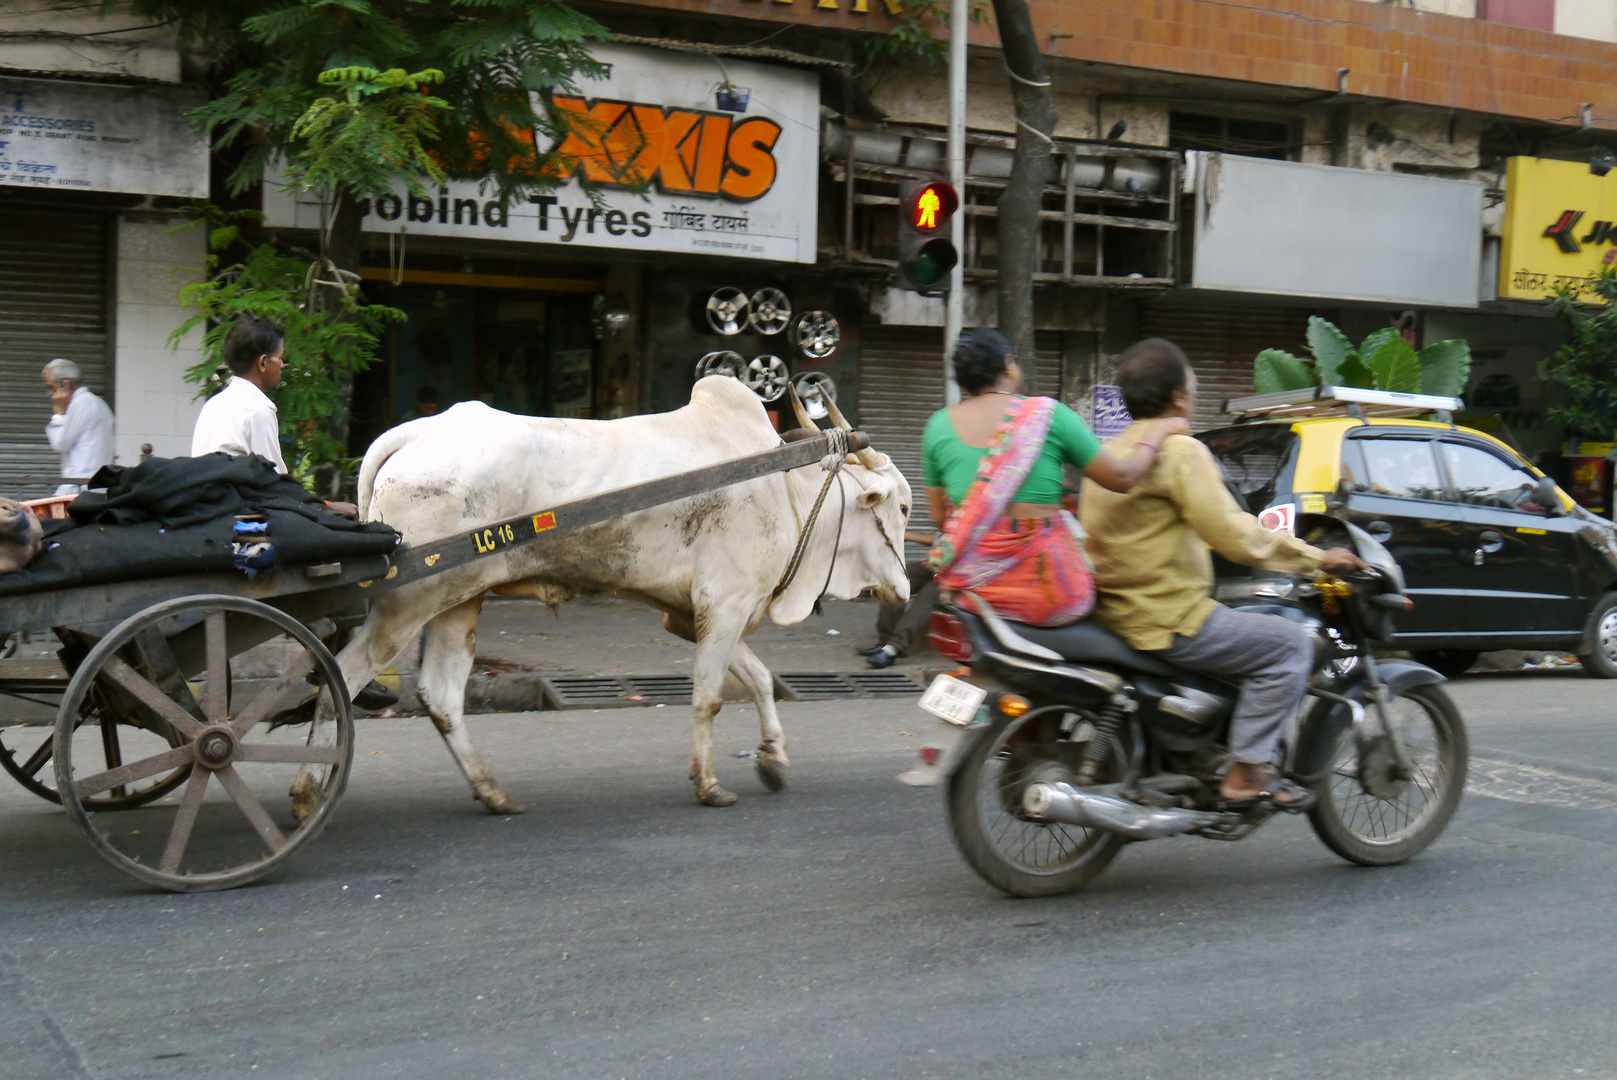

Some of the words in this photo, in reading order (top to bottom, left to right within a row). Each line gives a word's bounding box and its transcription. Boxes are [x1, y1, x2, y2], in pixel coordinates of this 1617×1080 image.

[3, 115, 96, 132] ACCESSORIES
[422, 86, 783, 204] XXIS
[360, 188, 508, 228] obind
[529, 195, 652, 242] Tyres
[475, 529, 496, 553] LC
[498, 524, 514, 544] 16
